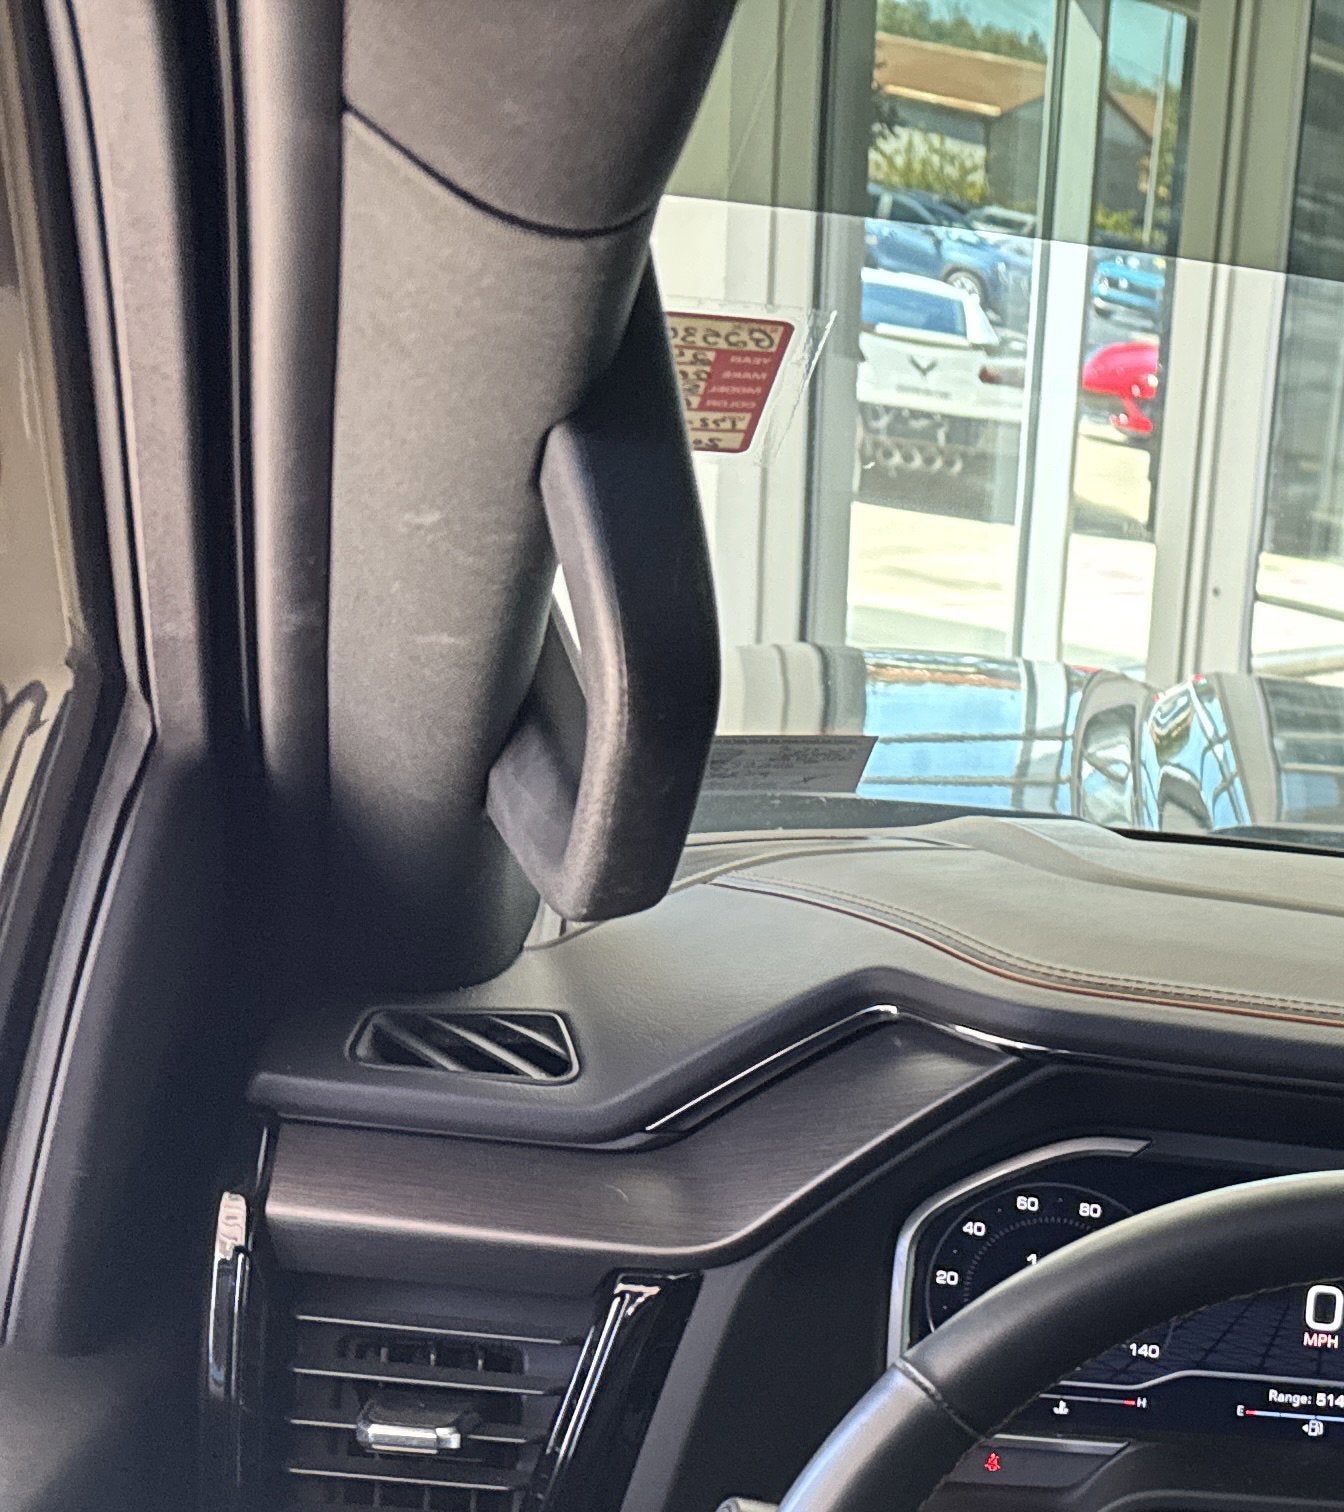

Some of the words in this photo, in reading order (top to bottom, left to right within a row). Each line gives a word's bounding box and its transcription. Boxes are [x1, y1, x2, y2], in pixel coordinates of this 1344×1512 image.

[1016, 1195, 1039, 1212] 60
[1079, 1203, 1102, 1218] 80
[962, 1221, 986, 1236] 40
[935, 1270, 958, 1285] 20
[1305, 1284, 1344, 1332] 0
[1303, 1332, 1339, 1349] MPH
[1129, 1343, 1160, 1359] 140
[1137, 1398, 1147, 1408] H
[1268, 1389, 1312, 1408] Range:
[1236, 1405, 1245, 1416] E
